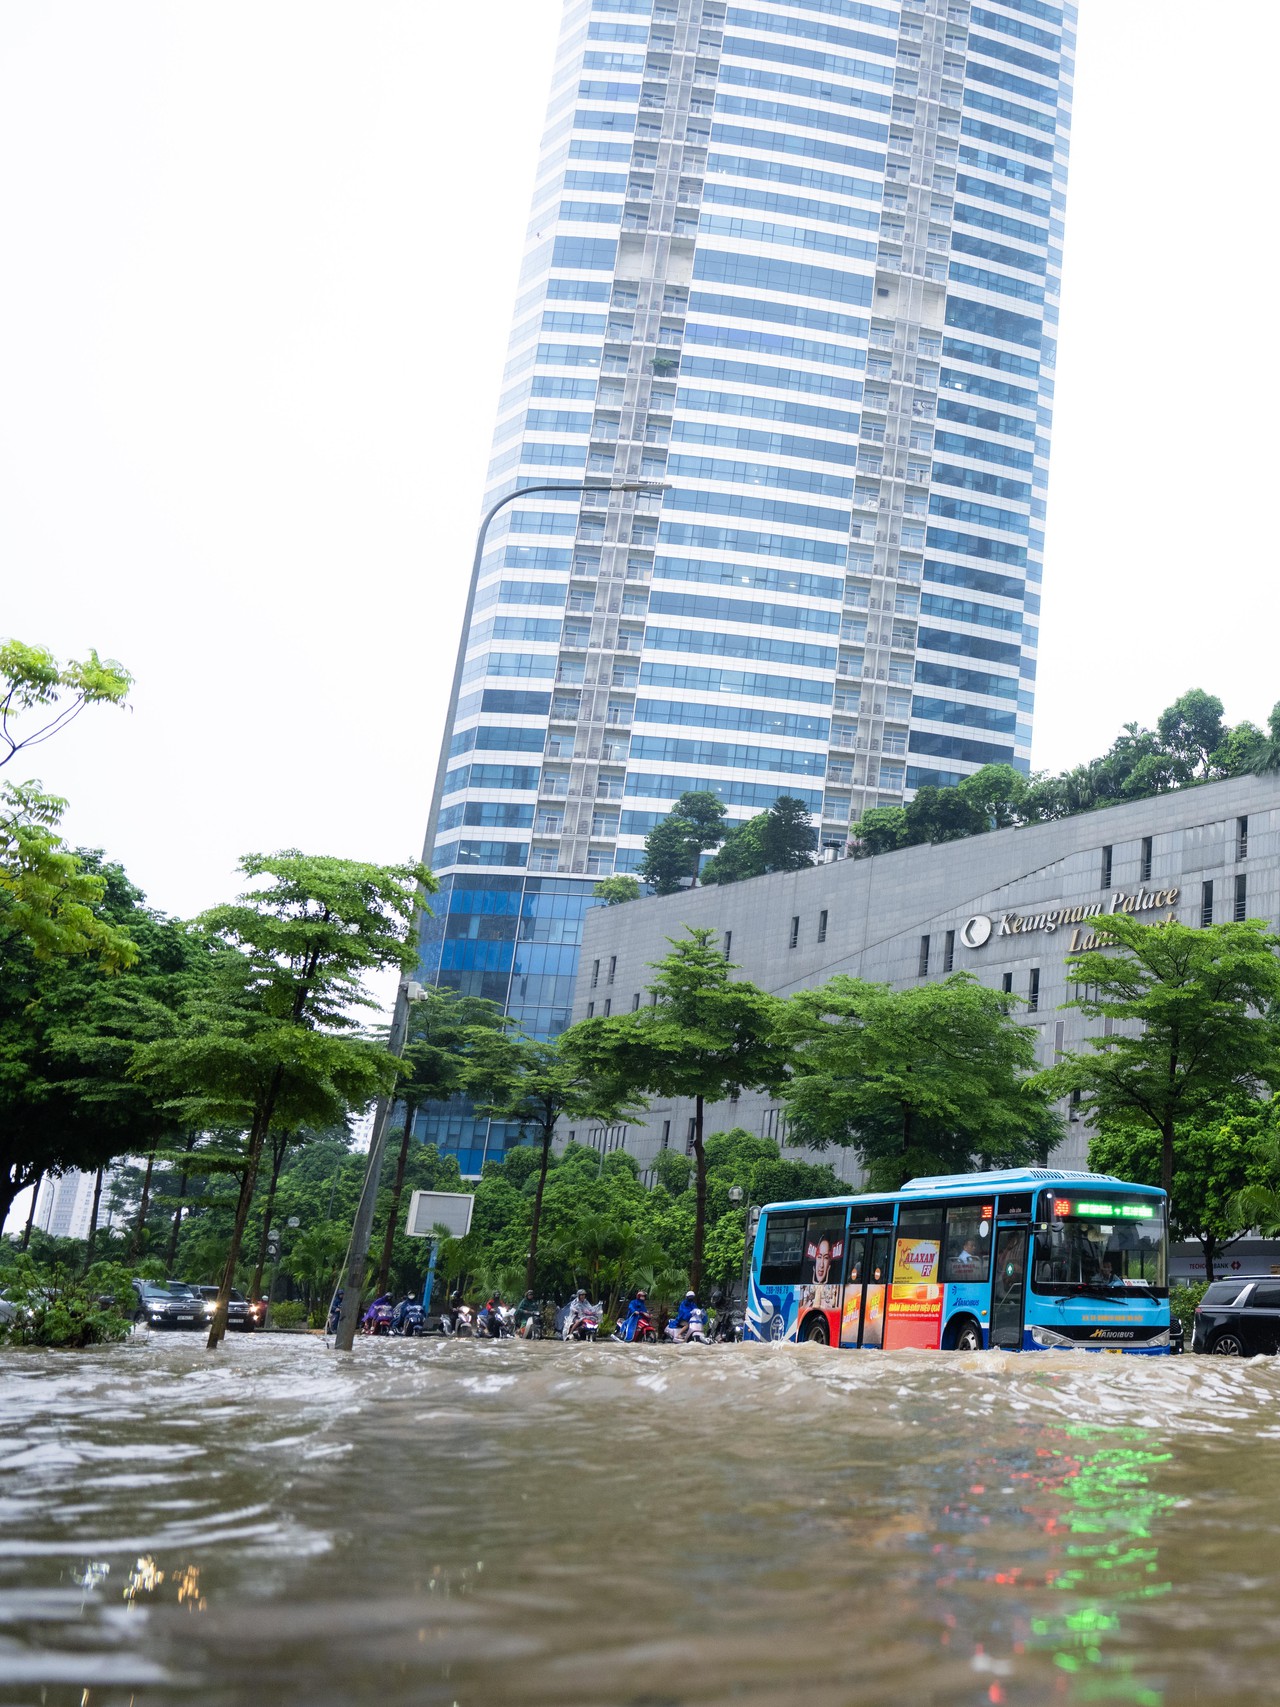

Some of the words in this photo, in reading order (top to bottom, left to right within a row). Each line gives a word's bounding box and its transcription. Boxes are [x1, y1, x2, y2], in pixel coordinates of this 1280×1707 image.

[997, 903, 1102, 934] Keangnam
[1109, 887, 1179, 915] Palace
[904, 1252, 936, 1263] ALAXAN
[1089, 1329, 1135, 1338] HANOIBUS
